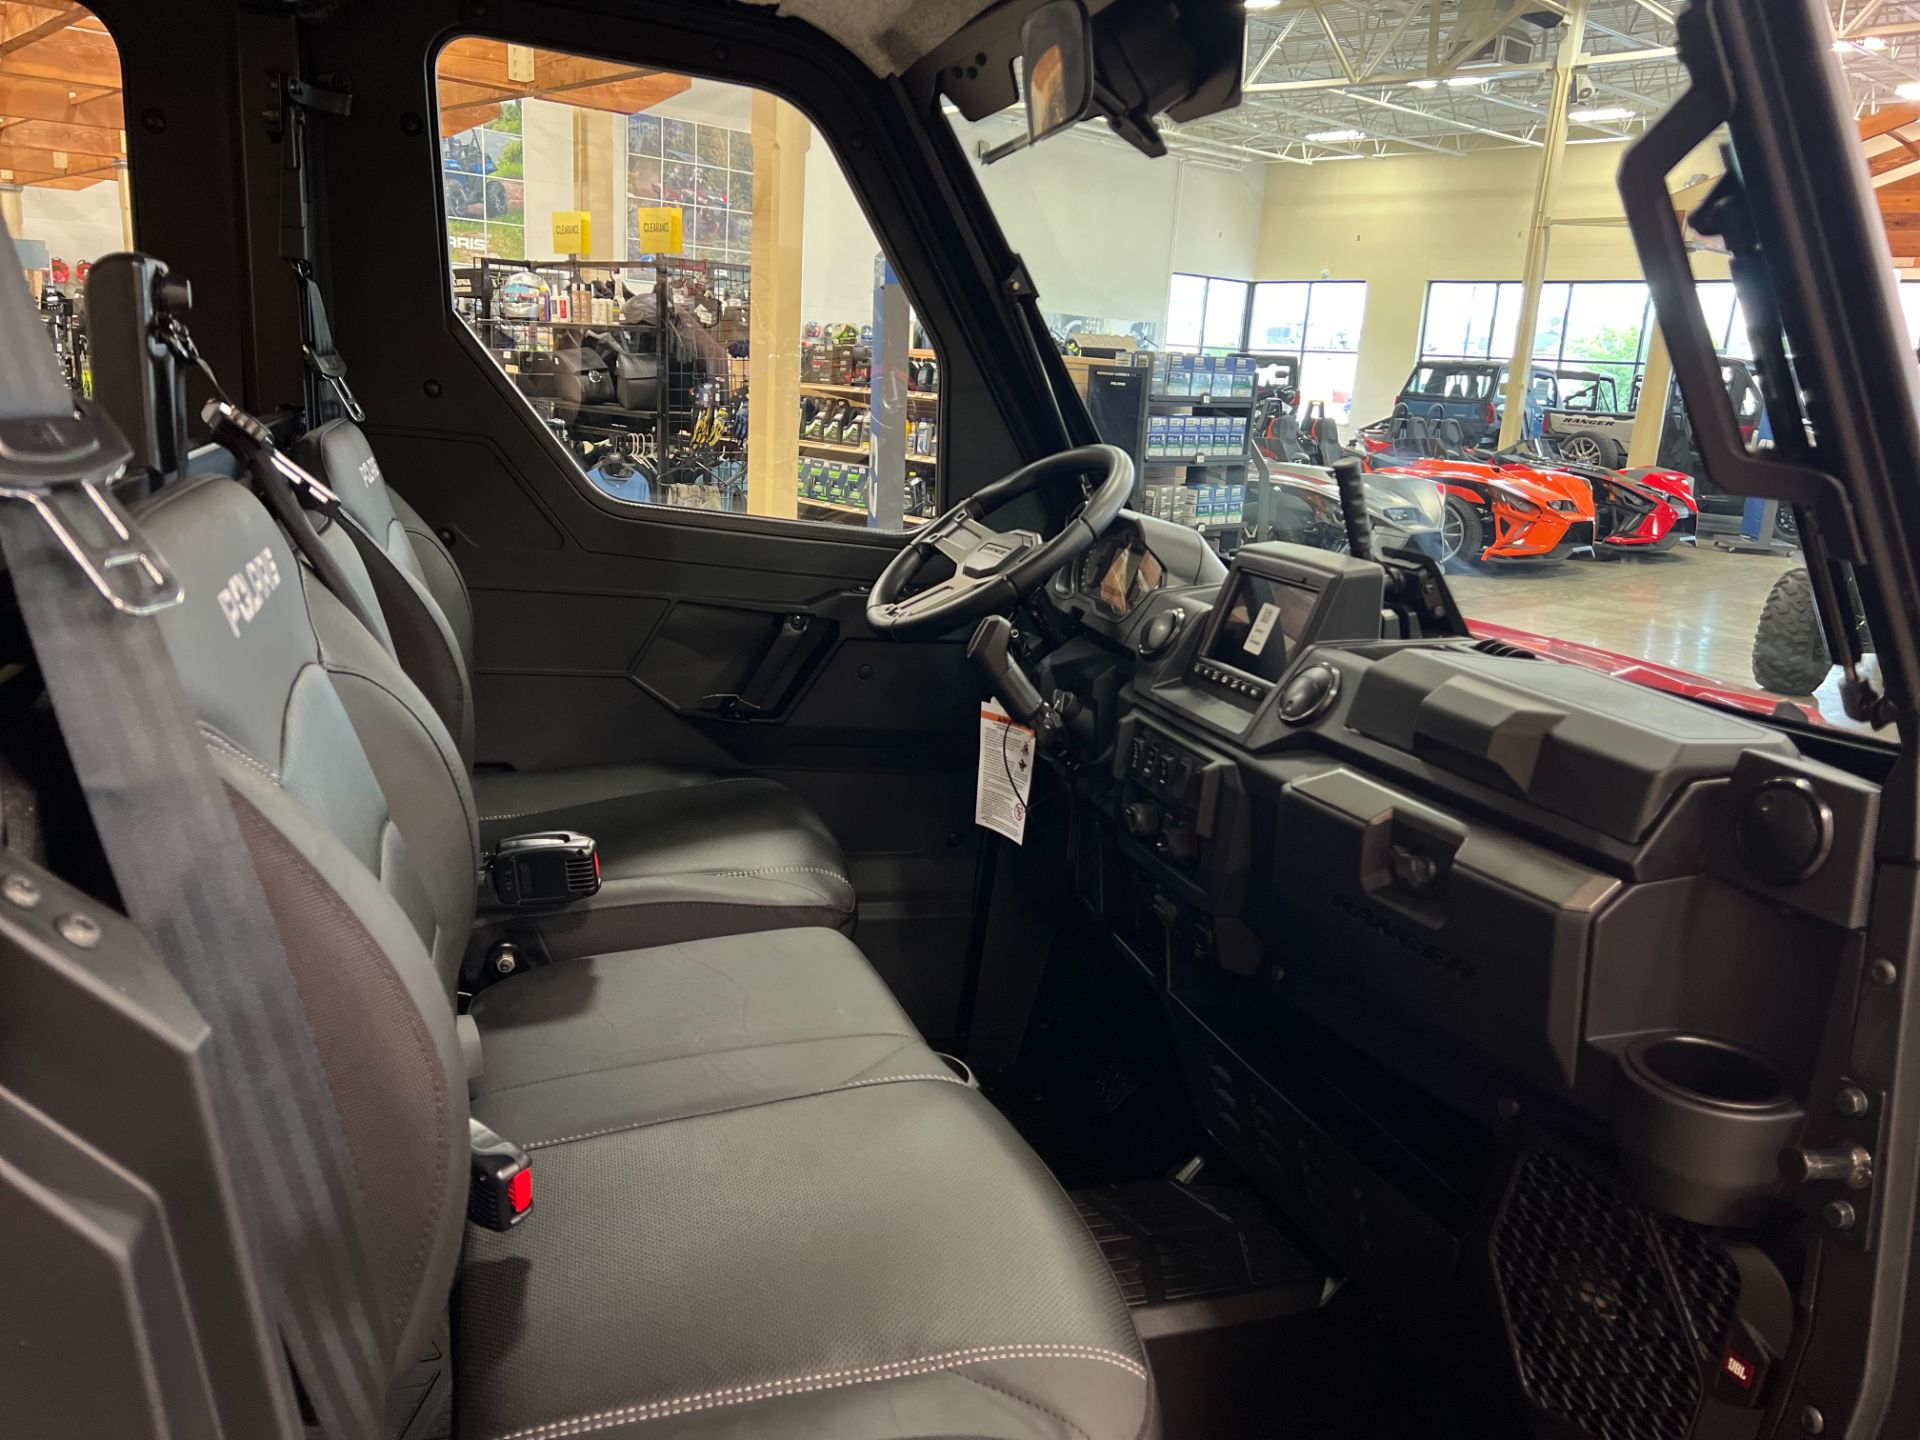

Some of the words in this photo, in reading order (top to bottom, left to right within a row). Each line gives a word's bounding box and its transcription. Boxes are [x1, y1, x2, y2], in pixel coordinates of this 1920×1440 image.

[555, 224, 580, 235] CLEARANCE
[643, 222, 670, 233] CLEARANCE
[1563, 417, 1615, 426] RANGER
[1727, 1357, 1747, 1380] JBL
